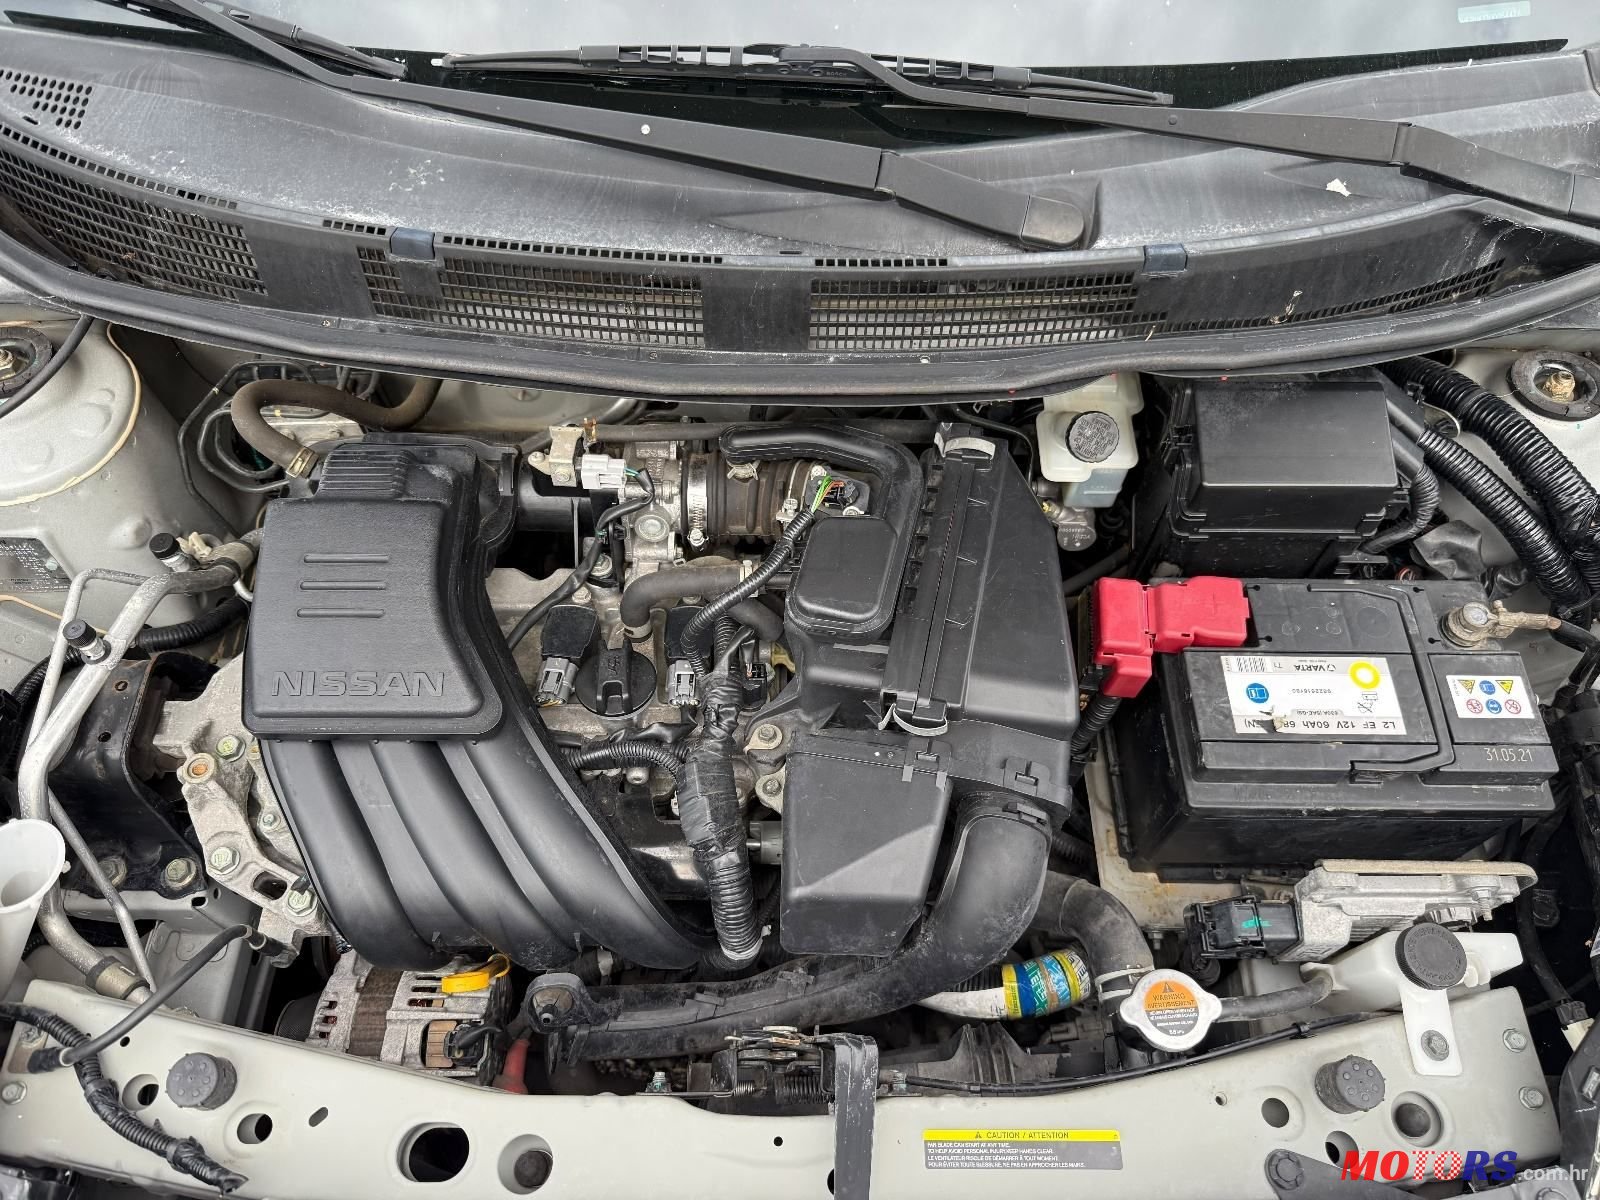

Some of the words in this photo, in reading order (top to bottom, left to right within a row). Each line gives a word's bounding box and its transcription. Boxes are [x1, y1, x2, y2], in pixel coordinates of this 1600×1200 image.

[1293, 664, 1325, 672] VARTA
[271, 671, 445, 697] NISSAN
[1302, 720, 1330, 729] 60Ah
[1336, 721, 1355, 729] 12V
[1363, 721, 1376, 729] EF
[1384, 721, 1396, 729] L2
[1484, 747, 1533, 762] 31.05.21
[1152, 993, 1186, 1001] WARNING
[986, 1131, 1020, 1139] CAUTION
[1028, 1131, 1069, 1139] ATTENTION
